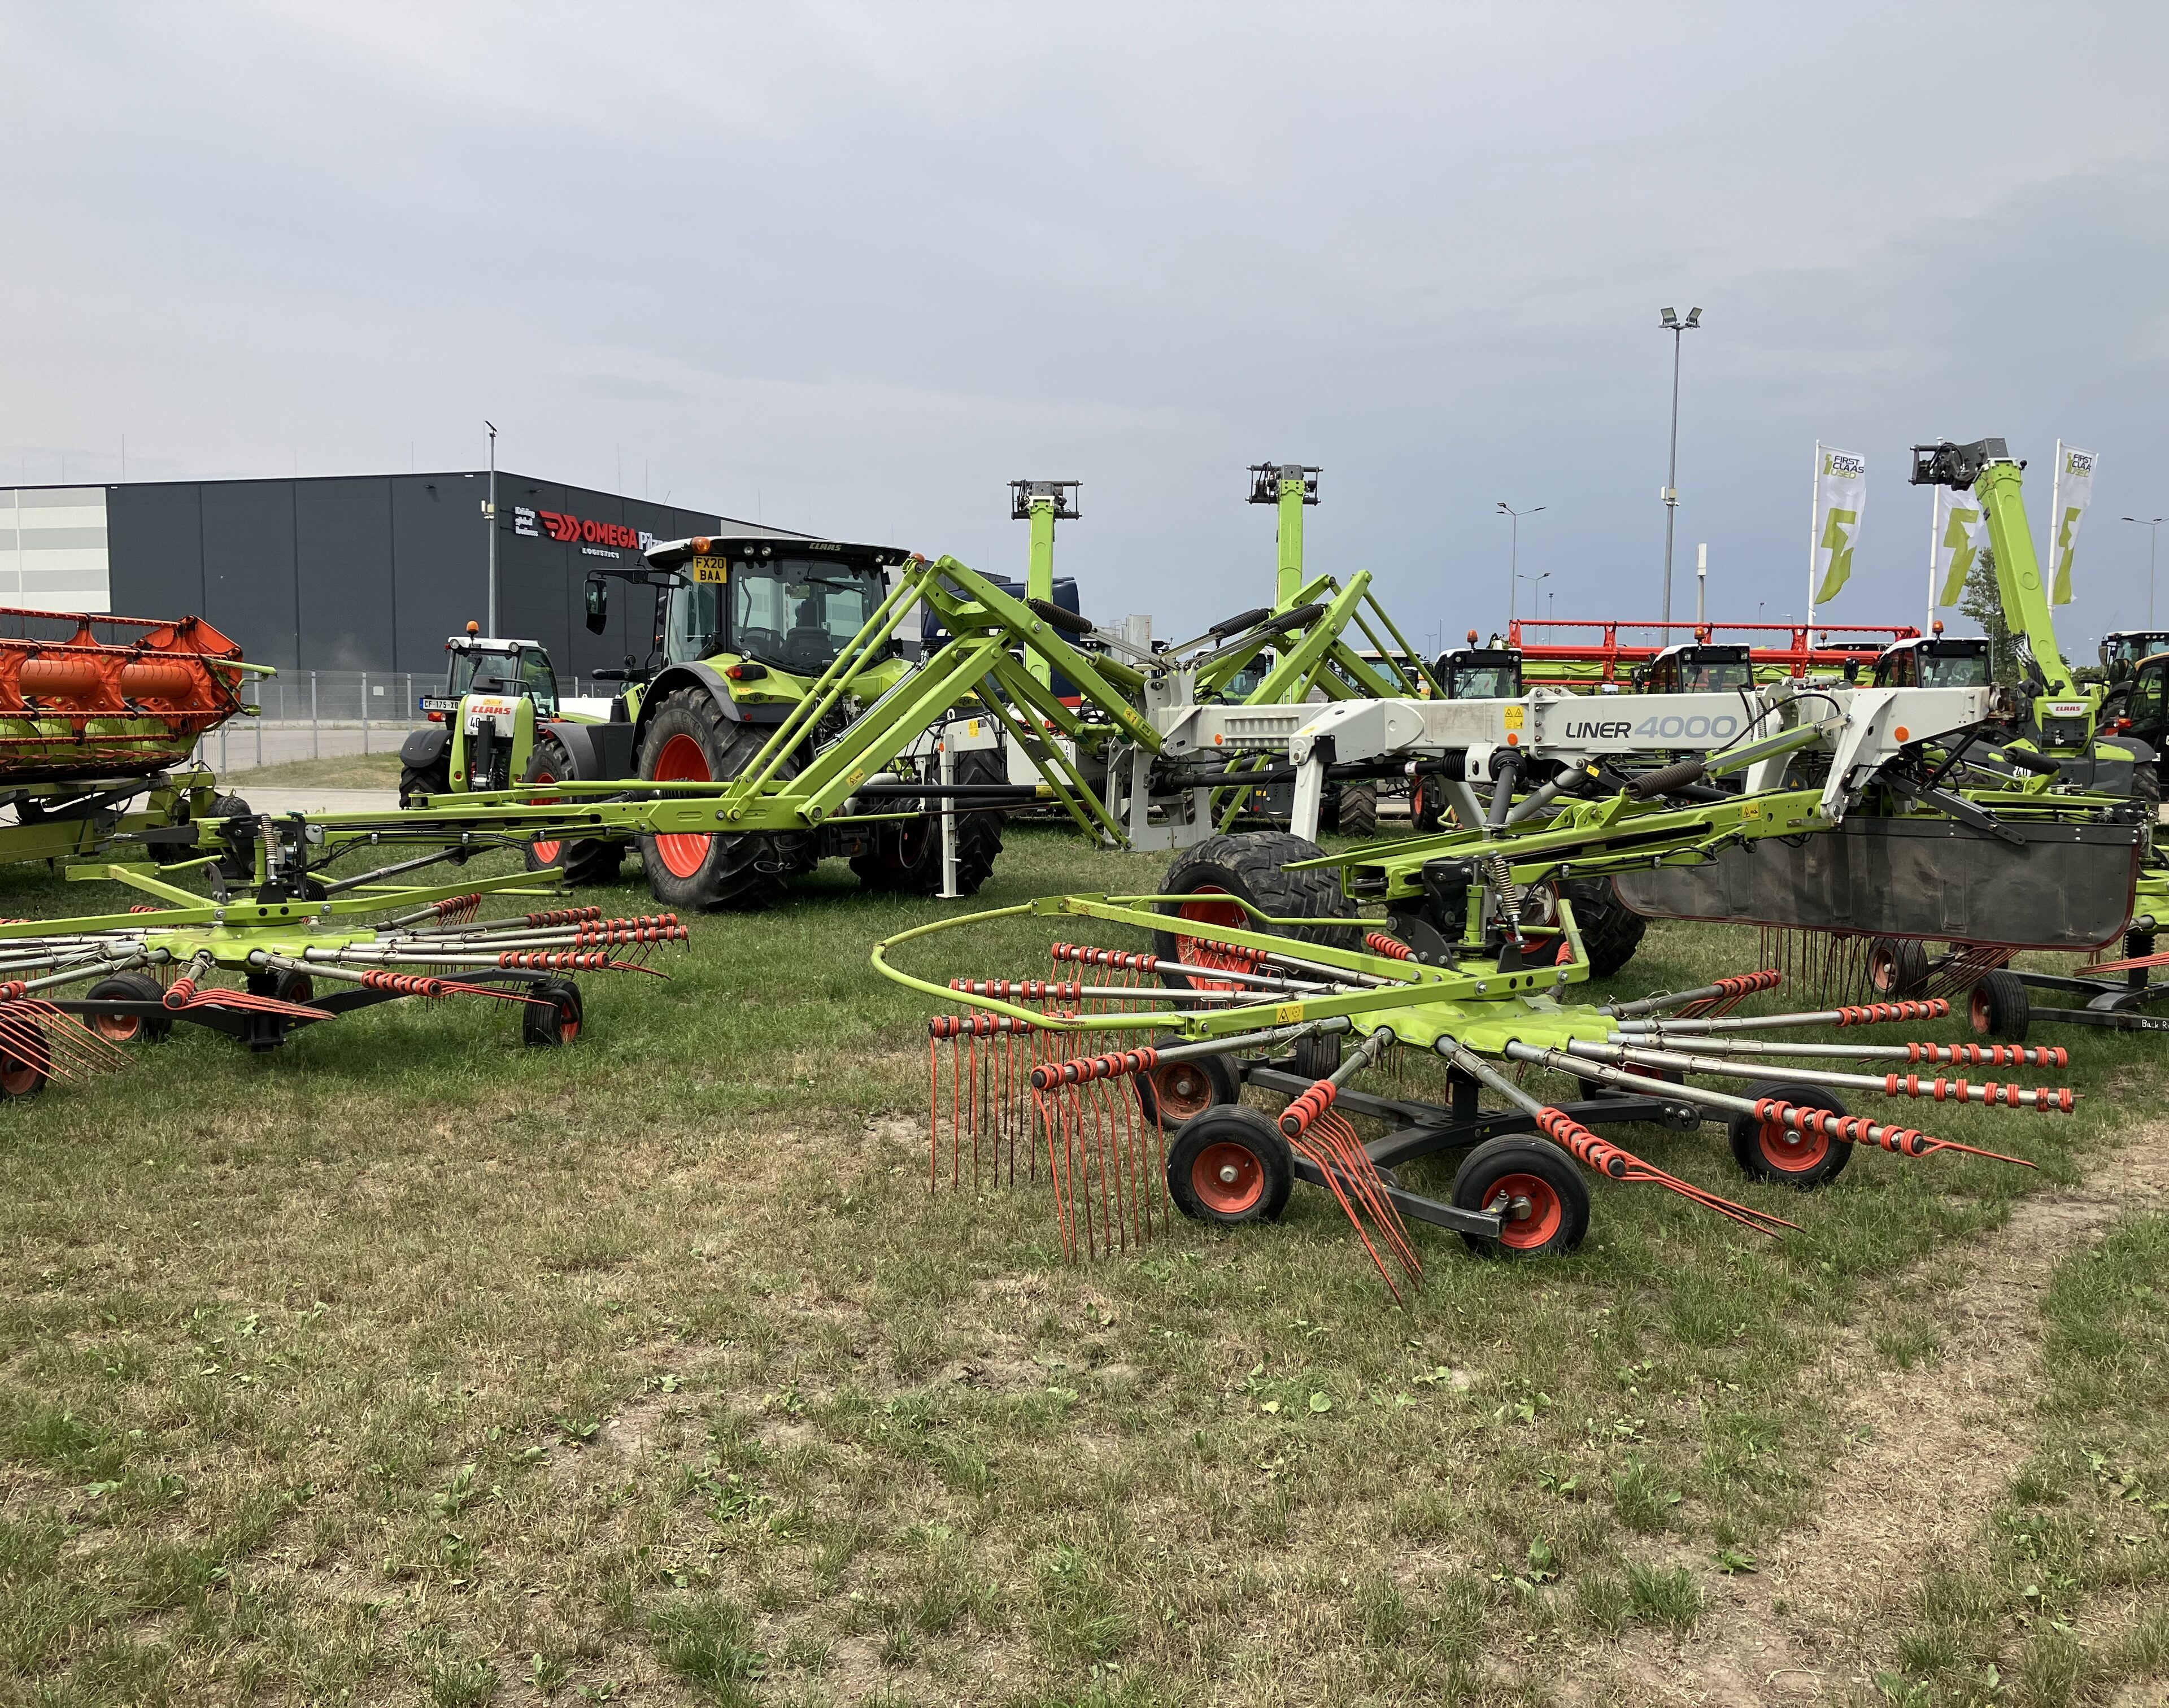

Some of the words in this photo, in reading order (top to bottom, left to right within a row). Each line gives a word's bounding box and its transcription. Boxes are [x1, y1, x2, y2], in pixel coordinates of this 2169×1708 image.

[1834, 455, 1860, 466] FIRST
[2072, 461, 2092, 471] CLAA
[1832, 462, 1865, 473] CLAAS
[1830, 469, 1857, 479] USED
[582, 520, 638, 550] OMEGA
[809, 542, 842, 551] CLAAS
[582, 547, 620, 559] LOGISTICS
[696, 557, 724, 568] FX20
[700, 569, 721, 581] BAA
[471, 706, 511, 714] CLAAS
[1566, 722, 1632, 738] LINER
[1634, 716, 1737, 738] 4000
